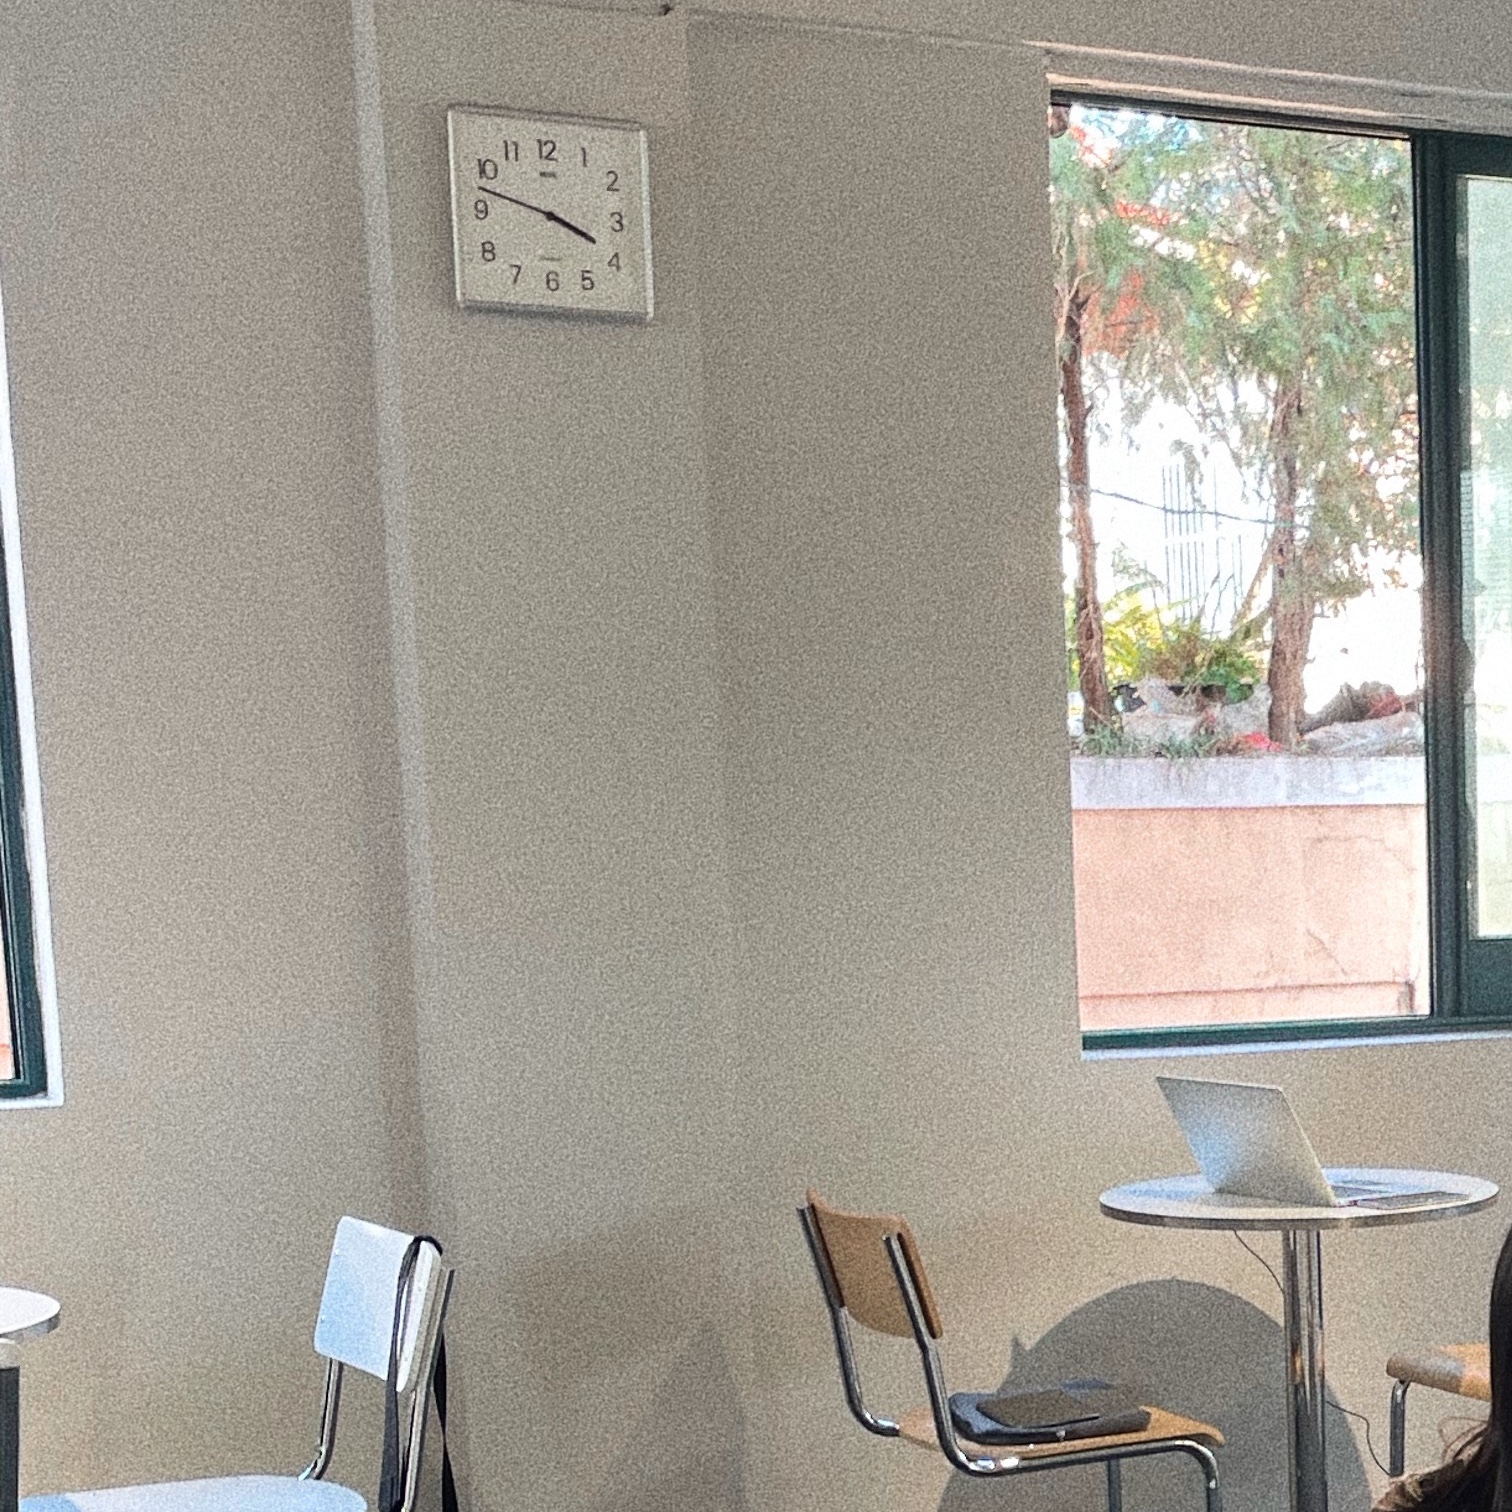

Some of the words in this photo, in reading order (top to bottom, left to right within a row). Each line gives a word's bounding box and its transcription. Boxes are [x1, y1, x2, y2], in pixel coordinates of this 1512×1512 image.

[503, 140, 519, 162] 11
[536, 139, 558, 162] 12
[581, 147, 588, 167] 1
[477, 158, 498, 180] 10
[606, 170, 620, 192] 2
[474, 199, 489, 220] 9
[610, 211, 624, 232] 3
[481, 241, 496, 262] 8
[607, 252, 621, 272] 4
[510, 264, 522, 284] 7
[546, 271, 560, 291] 6
[581, 269, 595, 291] 5
